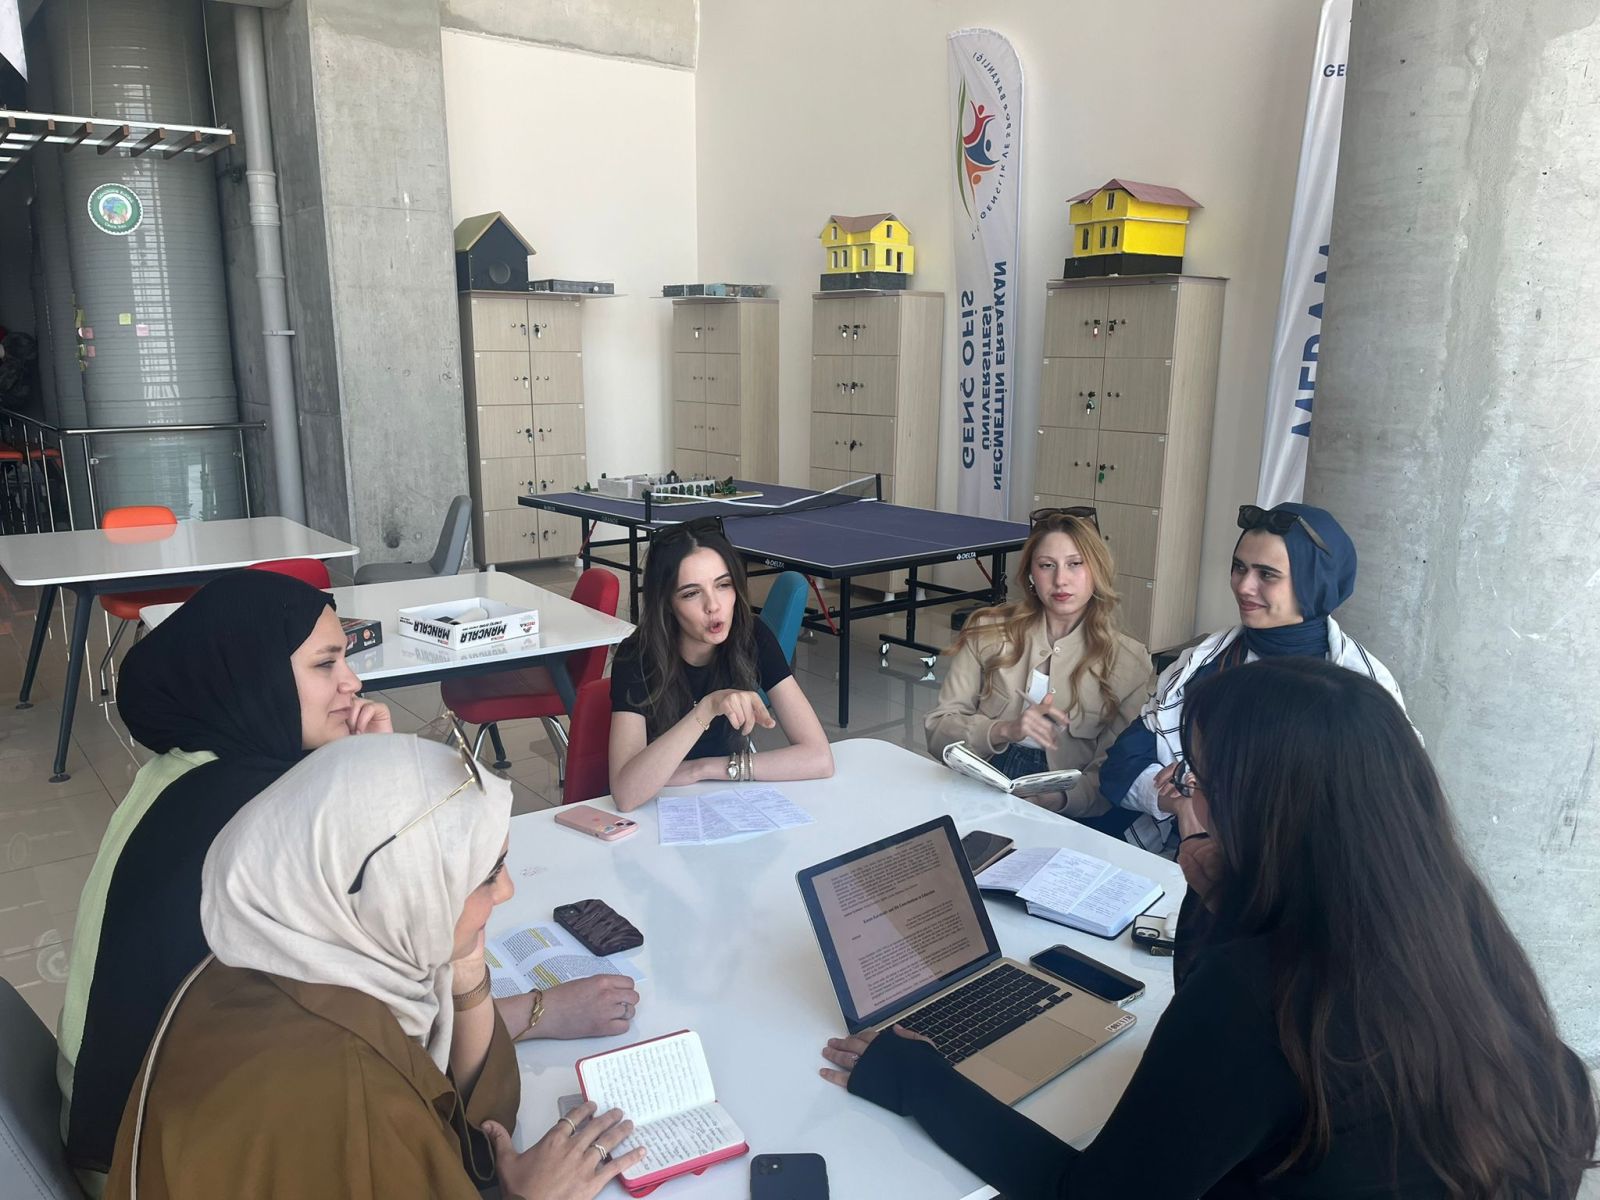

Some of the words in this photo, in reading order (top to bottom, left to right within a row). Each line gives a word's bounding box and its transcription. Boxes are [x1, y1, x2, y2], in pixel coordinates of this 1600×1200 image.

[1323, 63, 1346, 78] GE
[413, 620, 451, 641] MANCALA
[459, 623, 507, 644] MANCALA
